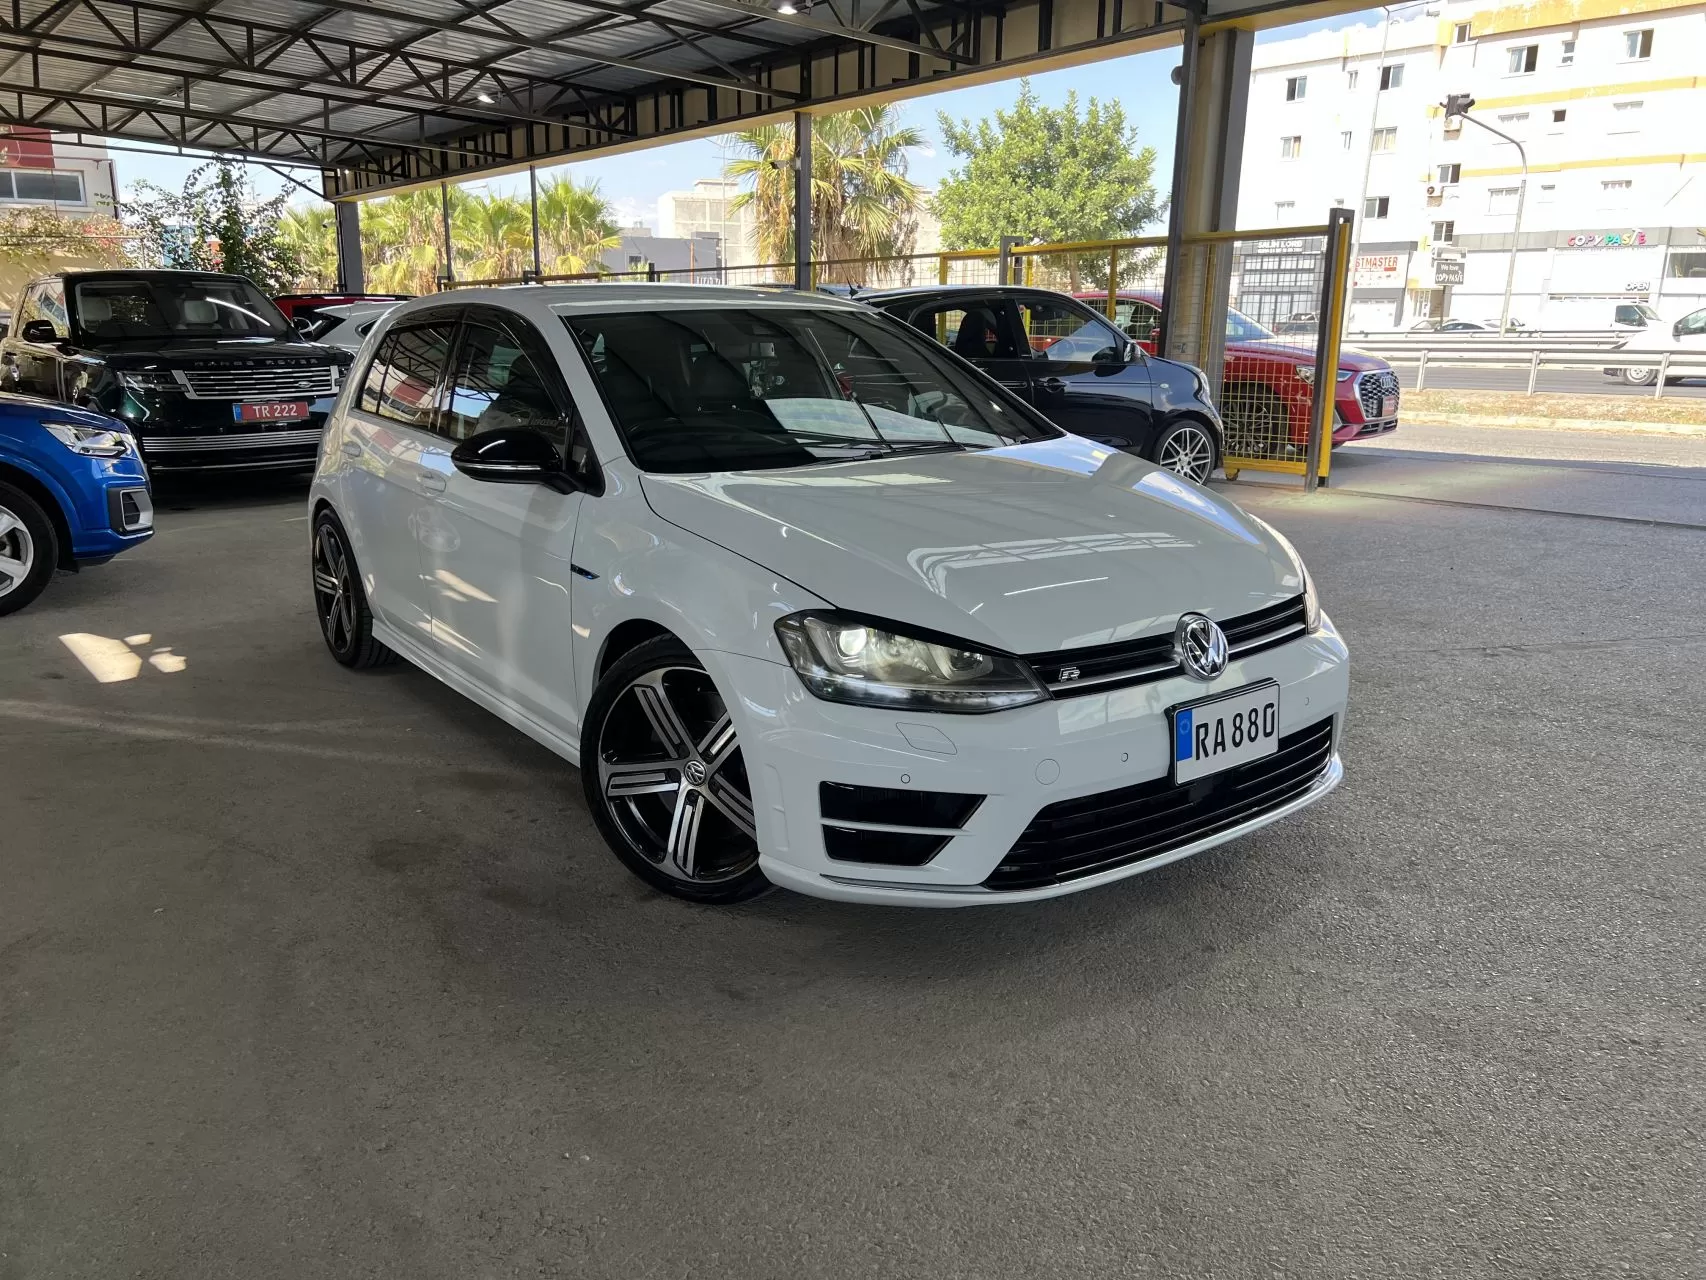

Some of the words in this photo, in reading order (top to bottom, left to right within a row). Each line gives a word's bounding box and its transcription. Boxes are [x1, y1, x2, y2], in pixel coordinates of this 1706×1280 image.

[1567, 234, 1604, 247] COPY
[1605, 228, 1646, 247] PASTE
[1355, 256, 1398, 268] STMASTER
[1435, 273, 1448, 282] COPY
[1448, 270, 1464, 282] PASTE
[1625, 280, 1651, 292] OPEN
[265, 358, 319, 366] ROVER
[252, 405, 270, 418] TR
[273, 404, 298, 418] 222
[1058, 666, 1081, 683] R
[1195, 702, 1276, 761] RA880
